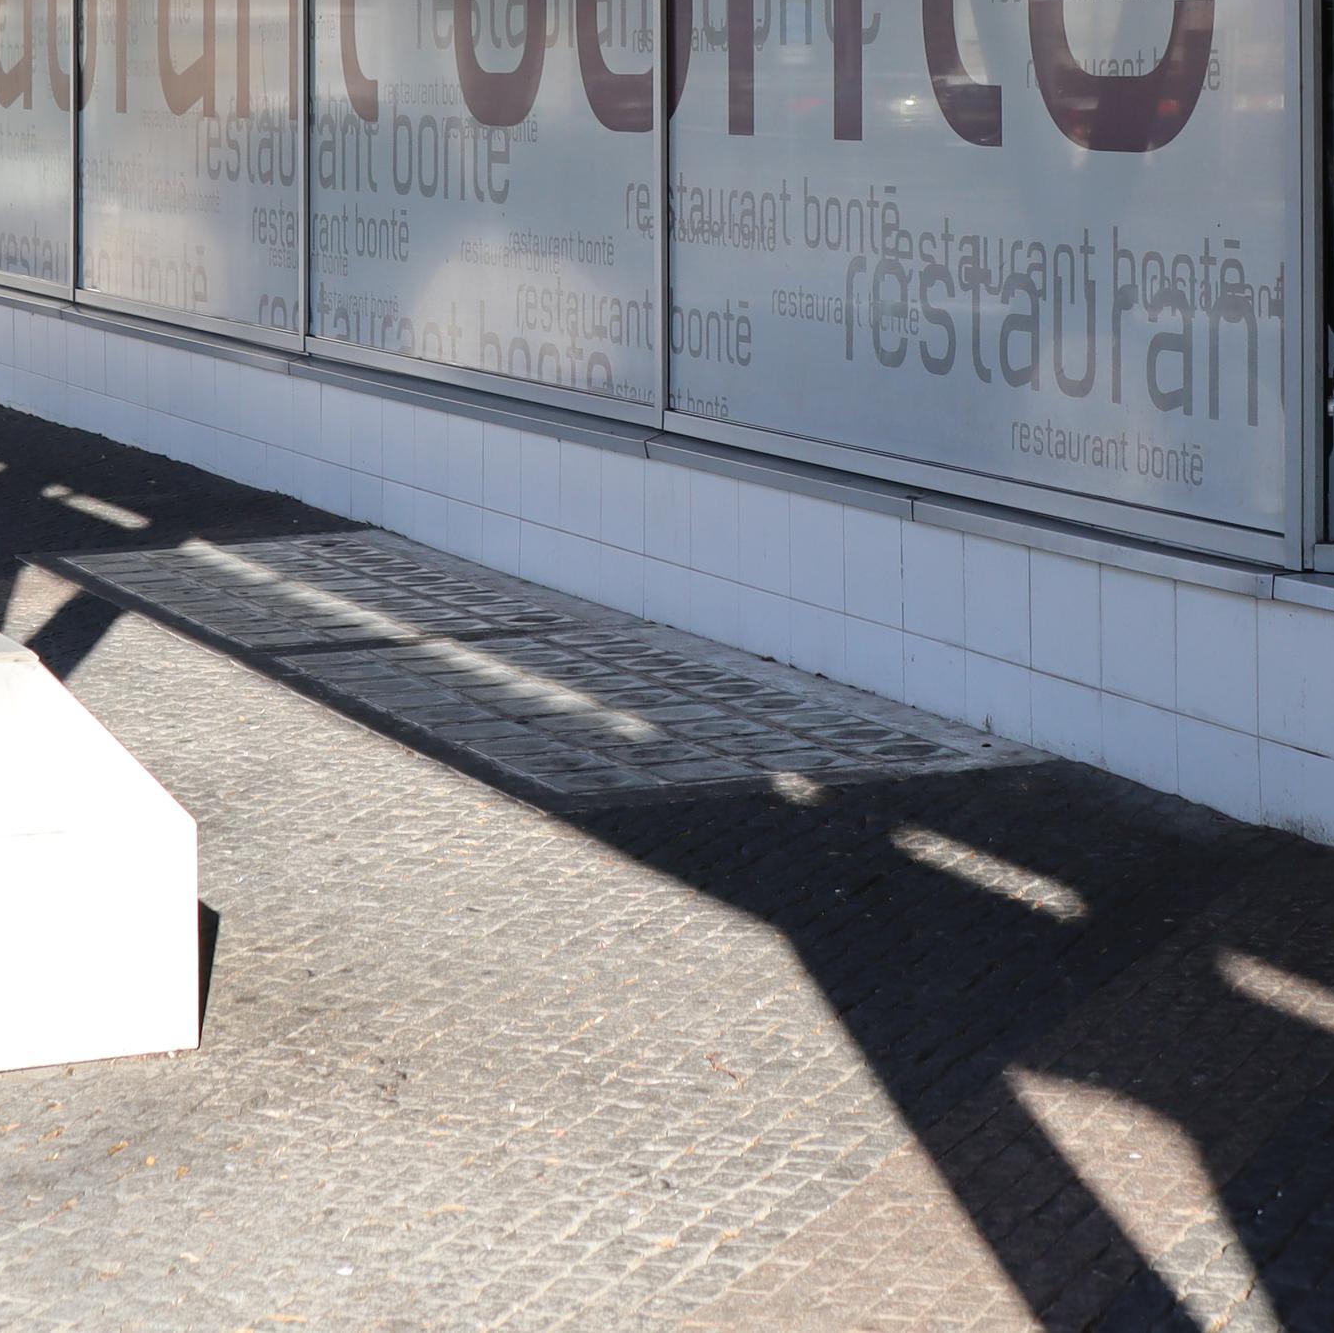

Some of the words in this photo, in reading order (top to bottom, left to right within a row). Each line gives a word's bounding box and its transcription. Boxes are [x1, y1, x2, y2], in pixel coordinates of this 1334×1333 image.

[251, 199, 349, 258] restarant
[355, 204, 411, 263] bontē
[508, 227, 576, 264] restaurant
[577, 231, 615, 267] bontē
[1011, 417, 1129, 474] restaurant
[1137, 436, 1205, 488] bontē
